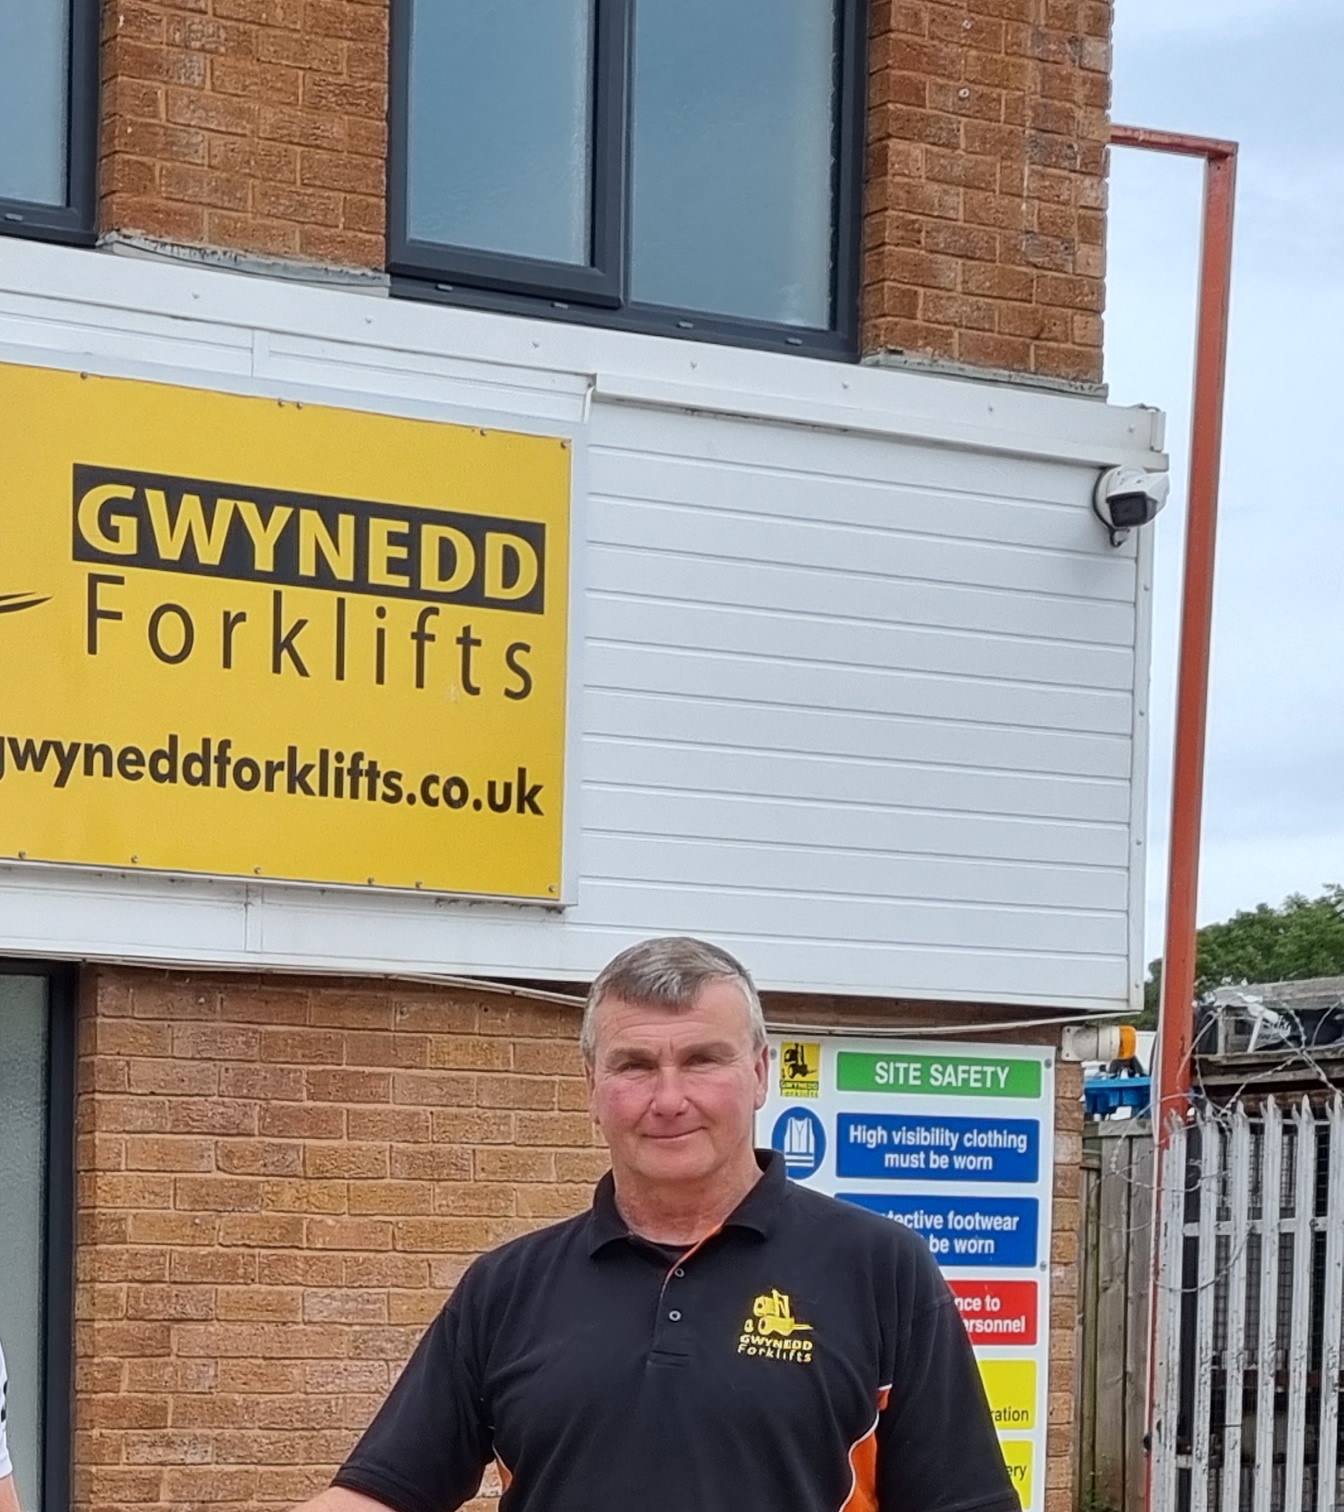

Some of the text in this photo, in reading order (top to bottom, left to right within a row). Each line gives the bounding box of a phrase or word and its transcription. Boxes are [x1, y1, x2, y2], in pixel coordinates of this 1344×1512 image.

[76, 483, 540, 602] GWYNEDD
[86, 571, 534, 702] Forklifts
[874, 1061, 1010, 1089] SITE SAFETY
[849, 1124, 1028, 1153] High visibility clothing
[884, 1151, 993, 1170] must be worn
[947, 1210, 1020, 1231] footwear
[929, 1233, 995, 1254] be worn
[985, 1294, 1001, 1312] to
[737, 1343, 812, 1363] Forklifts
[739, 1334, 813, 1351] GWYNEDD
